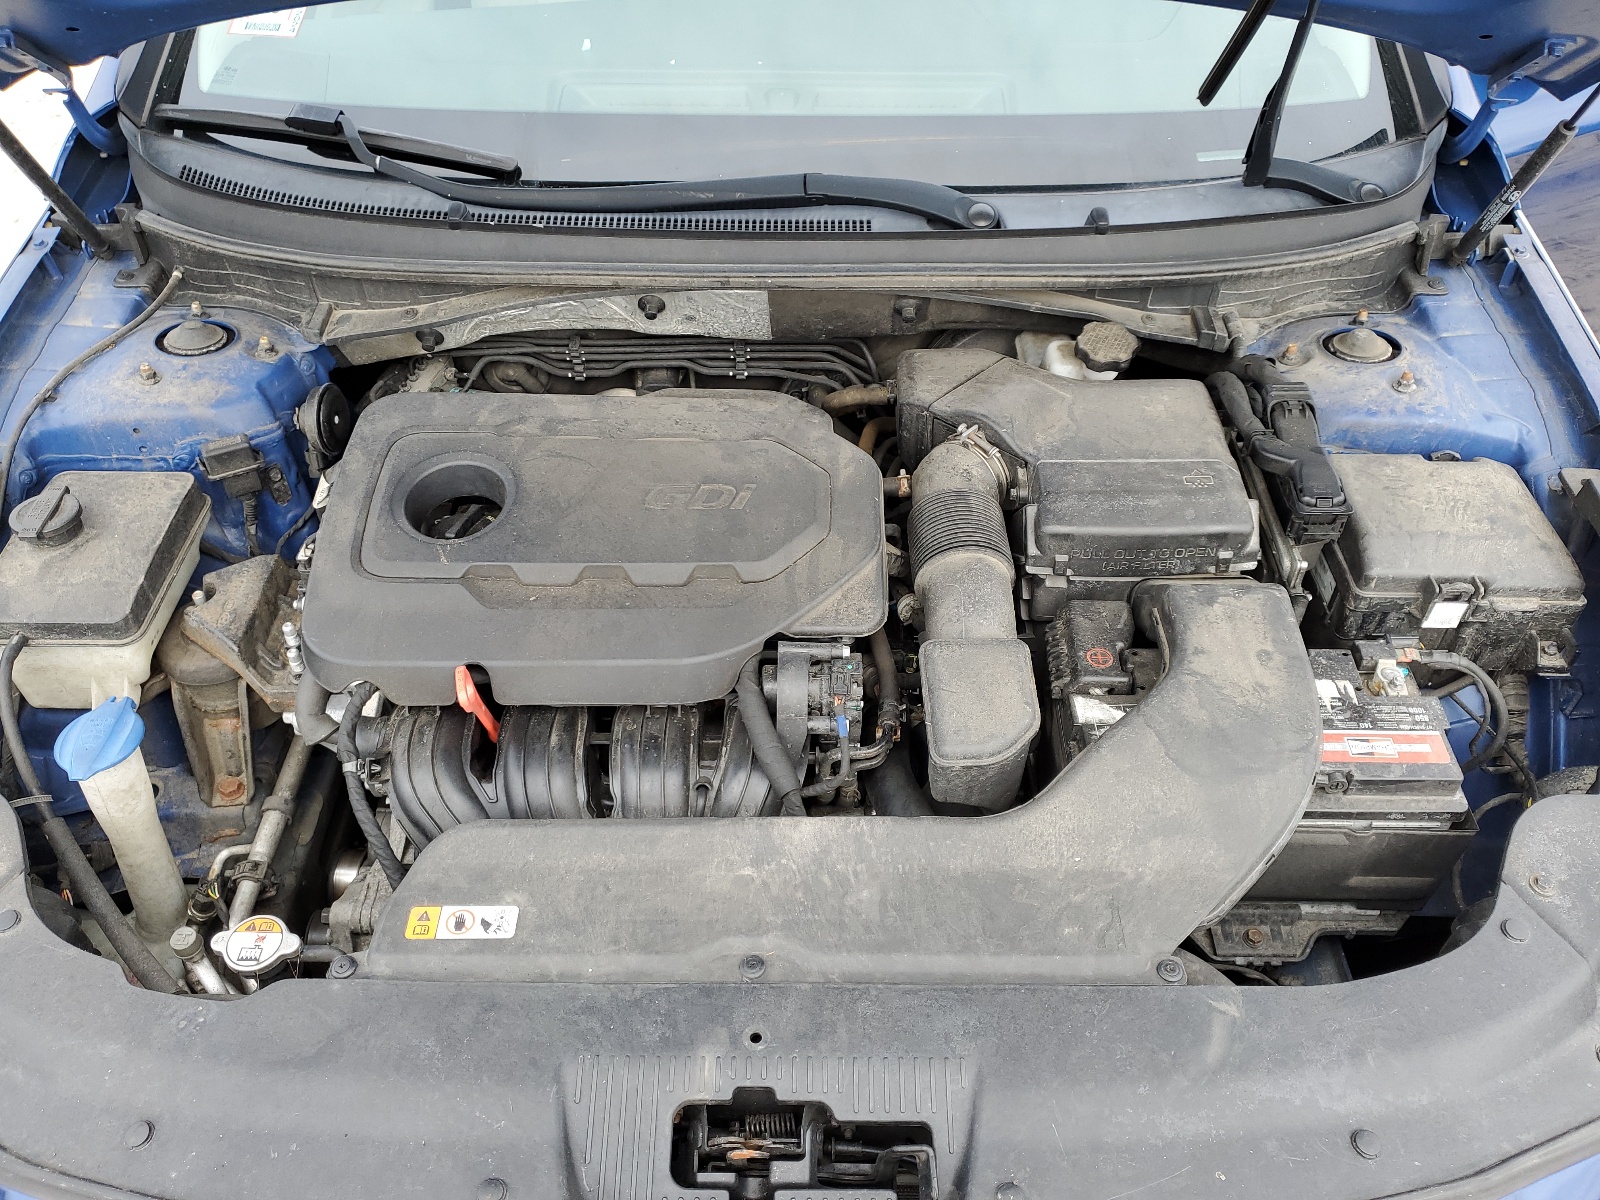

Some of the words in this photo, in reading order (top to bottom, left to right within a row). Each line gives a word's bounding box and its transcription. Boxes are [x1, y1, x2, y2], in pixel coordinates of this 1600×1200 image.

[1070, 548, 1110, 560] PULL
[1113, 548, 1146, 559] OUT
[1174, 547, 1218, 558] OPEN
